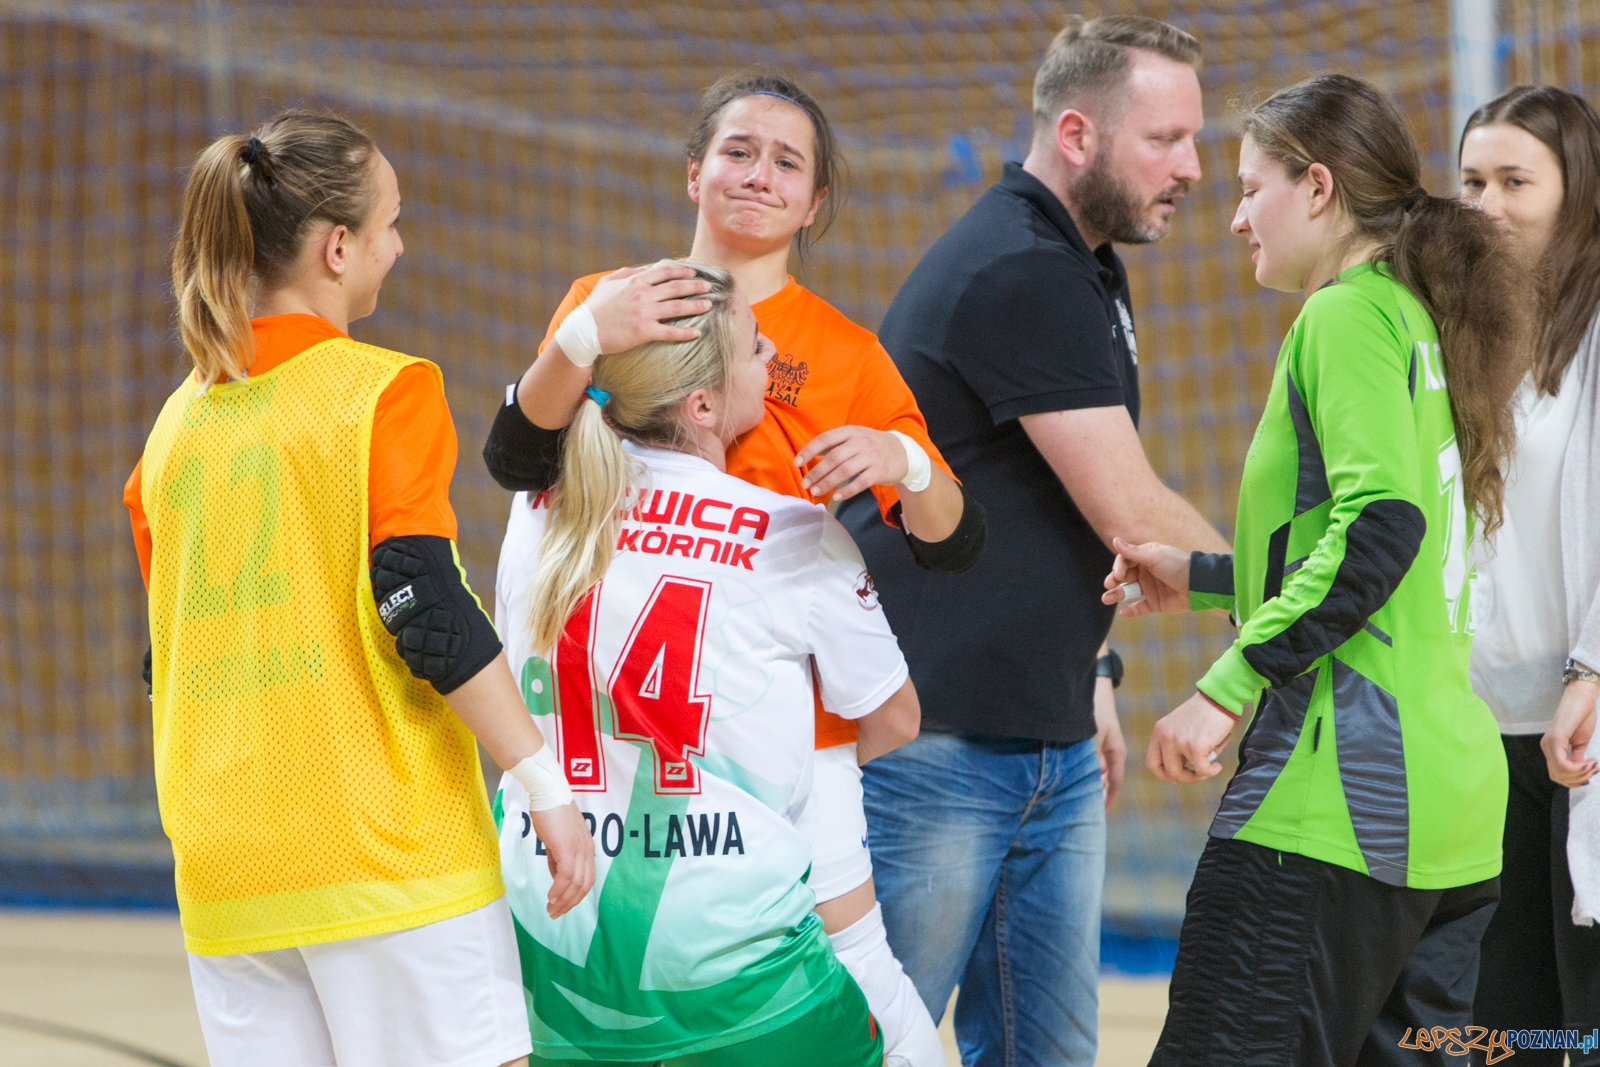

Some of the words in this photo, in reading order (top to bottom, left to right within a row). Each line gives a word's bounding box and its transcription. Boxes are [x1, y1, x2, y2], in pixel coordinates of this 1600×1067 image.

[166, 442, 290, 621] 12
[616, 525, 761, 571] KÓRNIK
[550, 574, 713, 795] 14
